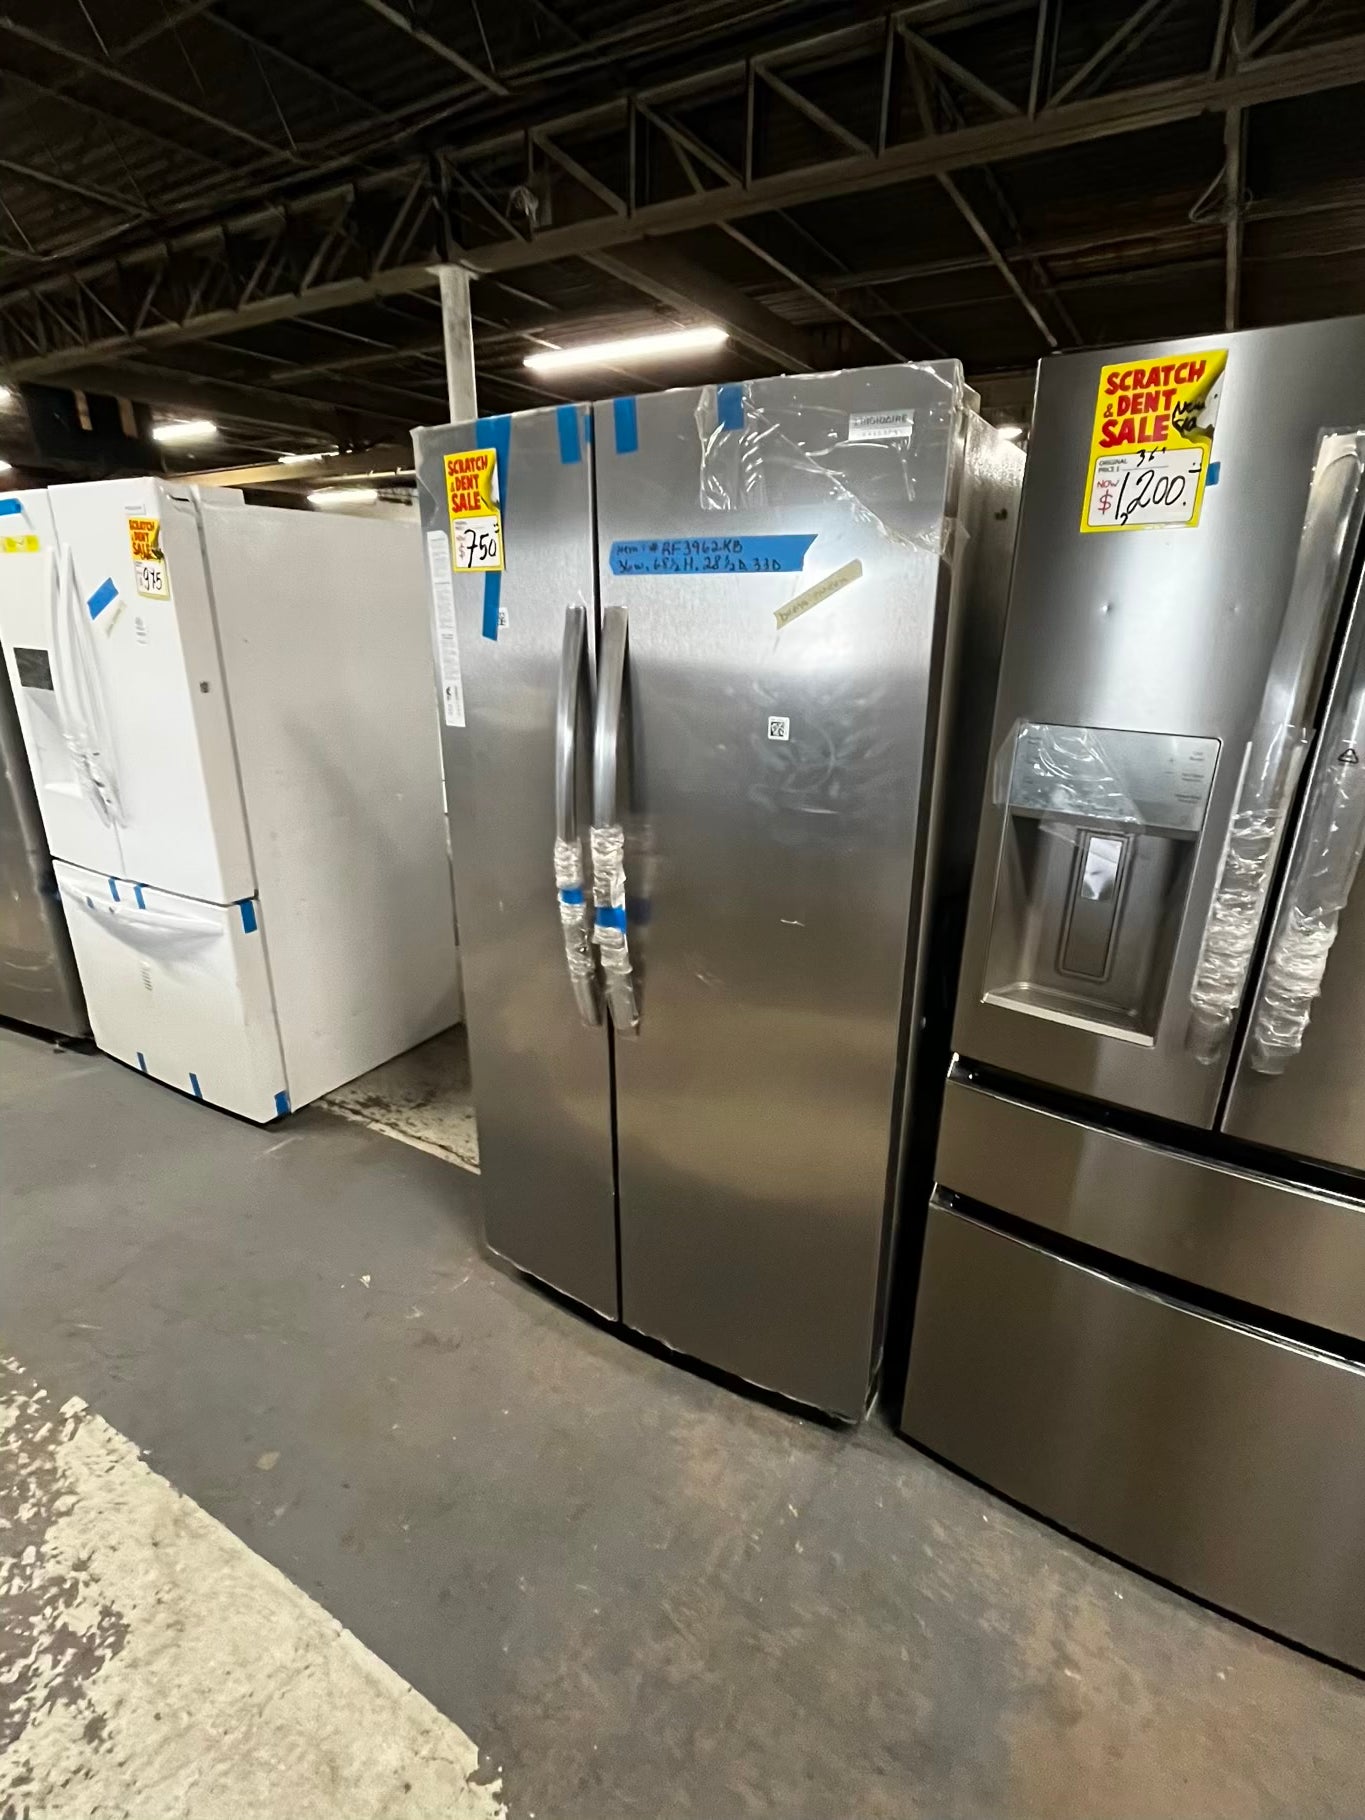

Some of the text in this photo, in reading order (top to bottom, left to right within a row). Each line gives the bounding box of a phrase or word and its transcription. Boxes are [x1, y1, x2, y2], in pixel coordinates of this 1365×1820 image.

[1105, 360, 1206, 395] SCRATCH
[1103, 388, 1177, 418] & DENT
[1099, 414, 1170, 448] SALE
[447, 455, 489, 477] SCRATCH
[1099, 458, 1128, 466] ORIGINAL
[455, 474, 479, 491] DENT
[1097, 479, 1119, 488] NOW
[452, 491, 481, 513] SALE
